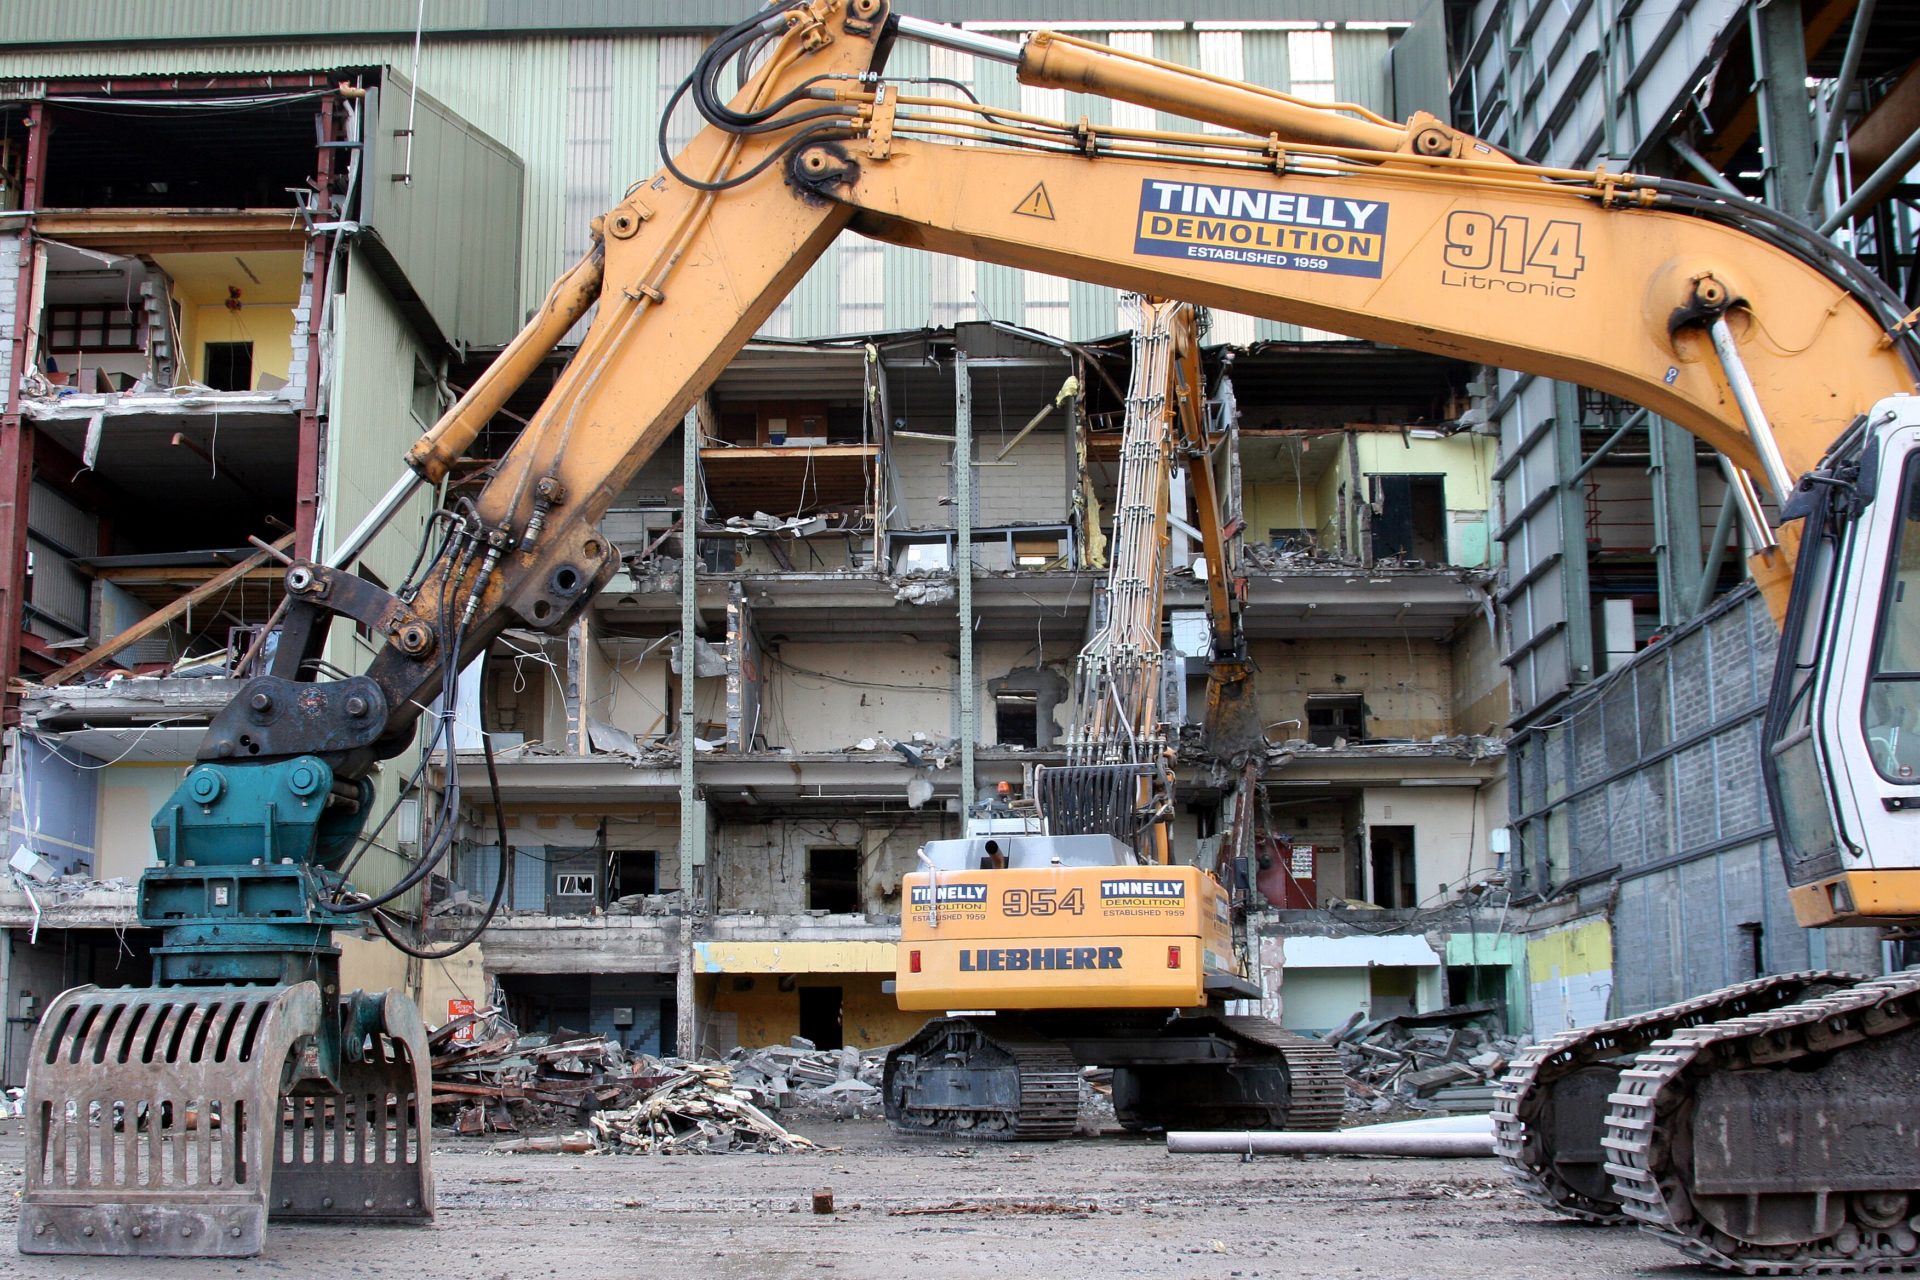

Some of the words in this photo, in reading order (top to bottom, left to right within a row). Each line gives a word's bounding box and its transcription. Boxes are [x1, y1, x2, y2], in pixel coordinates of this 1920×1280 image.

[1152, 182, 1378, 230] TINNELLY
[1150, 216, 1372, 256] DEMOLITION
[1443, 210, 1585, 280] 914
[1188, 246, 1288, 266] ESTABLISHED
[1293, 257, 1328, 270] 1959
[1441, 270, 1577, 299] Litronic
[1101, 882, 1183, 896] TINNELLY
[1105, 898, 1180, 906] DEMOLITION
[1002, 888, 1085, 917] 954
[1103, 909, 1162, 917] ESTABLISHED
[1165, 909, 1185, 917] 1959
[912, 913, 963, 922] ESTALISHED
[966, 913, 986, 921] 1959
[959, 946, 1123, 972] LIEBHERR
